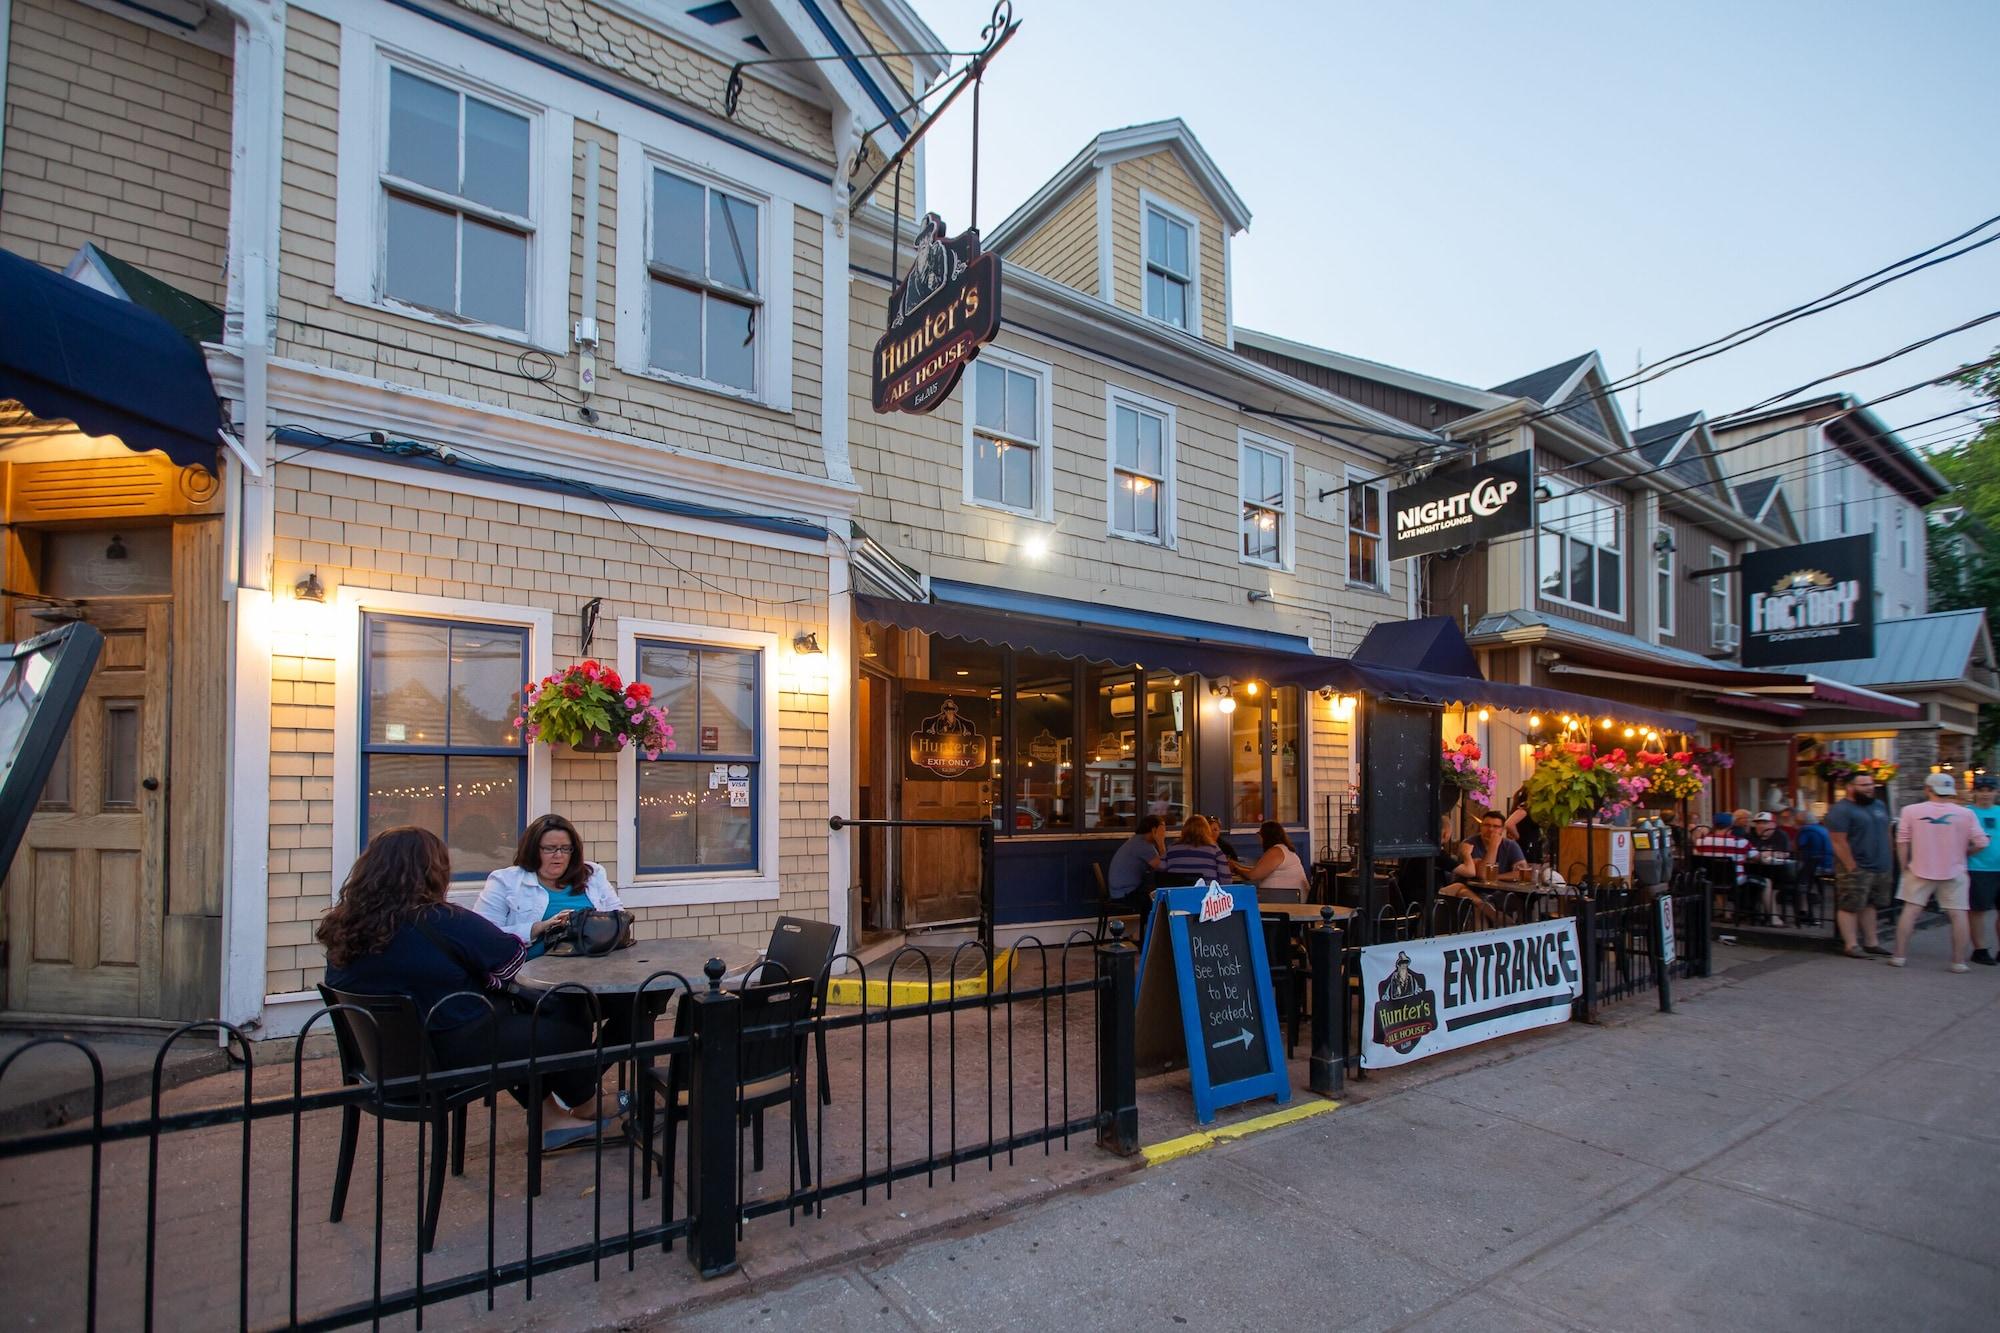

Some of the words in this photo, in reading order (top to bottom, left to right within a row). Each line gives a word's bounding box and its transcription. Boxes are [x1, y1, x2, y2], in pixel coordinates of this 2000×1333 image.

[879, 286, 980, 382] Hunter's
[889, 377, 912, 404] ALE
[915, 340, 965, 386] HOUSE
[1397, 528, 1416, 541] LATE
[1416, 522, 1441, 536] NIGHT
[1440, 515, 1473, 530] LOUNGE
[920, 739, 979, 755] Hunter's
[927, 758, 945, 766] EXIT
[948, 758, 971, 767] ONLY
[1205, 895, 1232, 919] Alpine
[1193, 936, 1230, 958] Please
[1195, 964, 1214, 979] see
[1217, 955, 1241, 976] host
[1443, 930, 1579, 1009] ENTRANCE
[1208, 984, 1221, 1000] to
[1223, 981, 1239, 1000] be
[1209, 988, 1254, 1026] seated!
[1379, 1001, 1431, 1030] Hunter's
[1387, 1032, 1399, 1044] ALE
[1400, 1025, 1427, 1039] HOUSE
